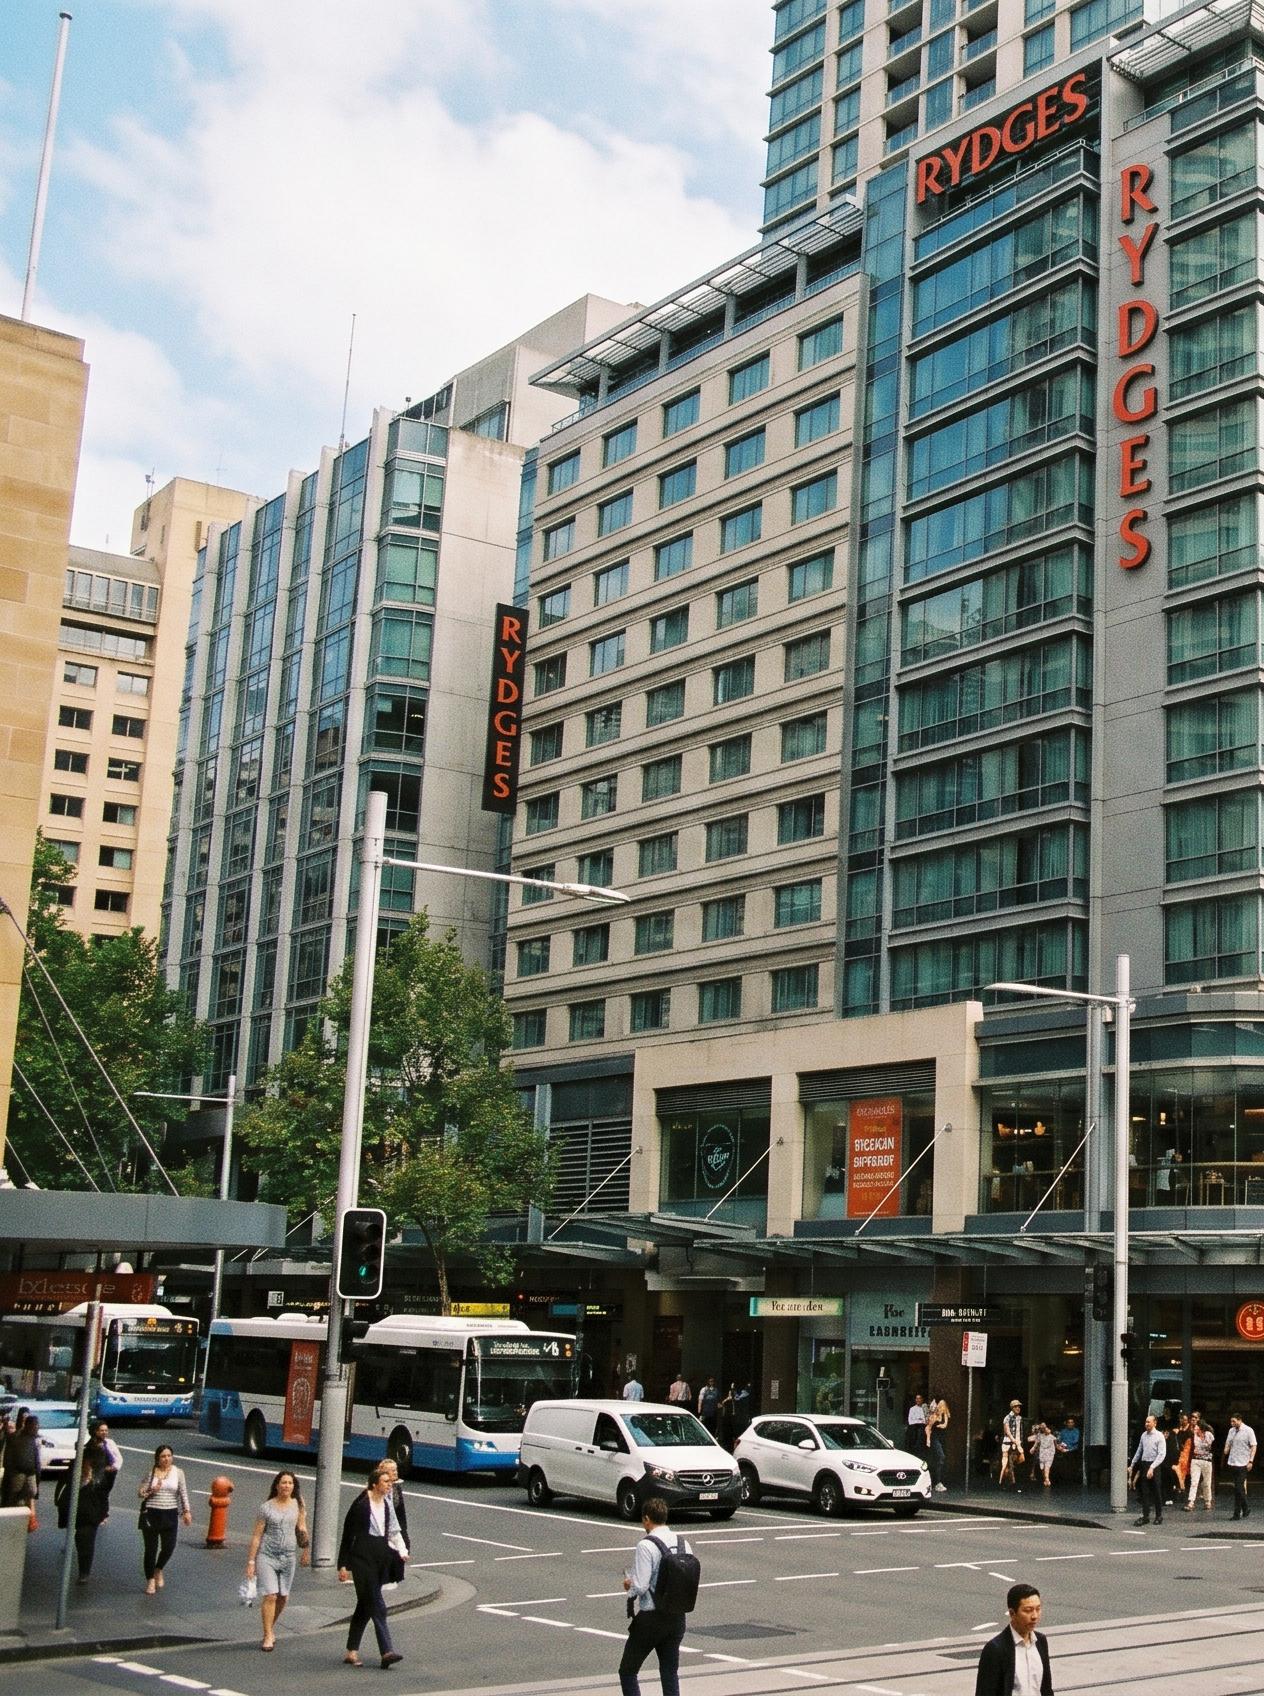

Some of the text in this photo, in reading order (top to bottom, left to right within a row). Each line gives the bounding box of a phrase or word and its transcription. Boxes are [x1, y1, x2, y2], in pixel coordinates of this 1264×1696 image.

[916, 73, 1089, 204] RYDGES
[1112, 164, 1159, 571] RYDGES
[493, 615, 522, 799] RYDGES
